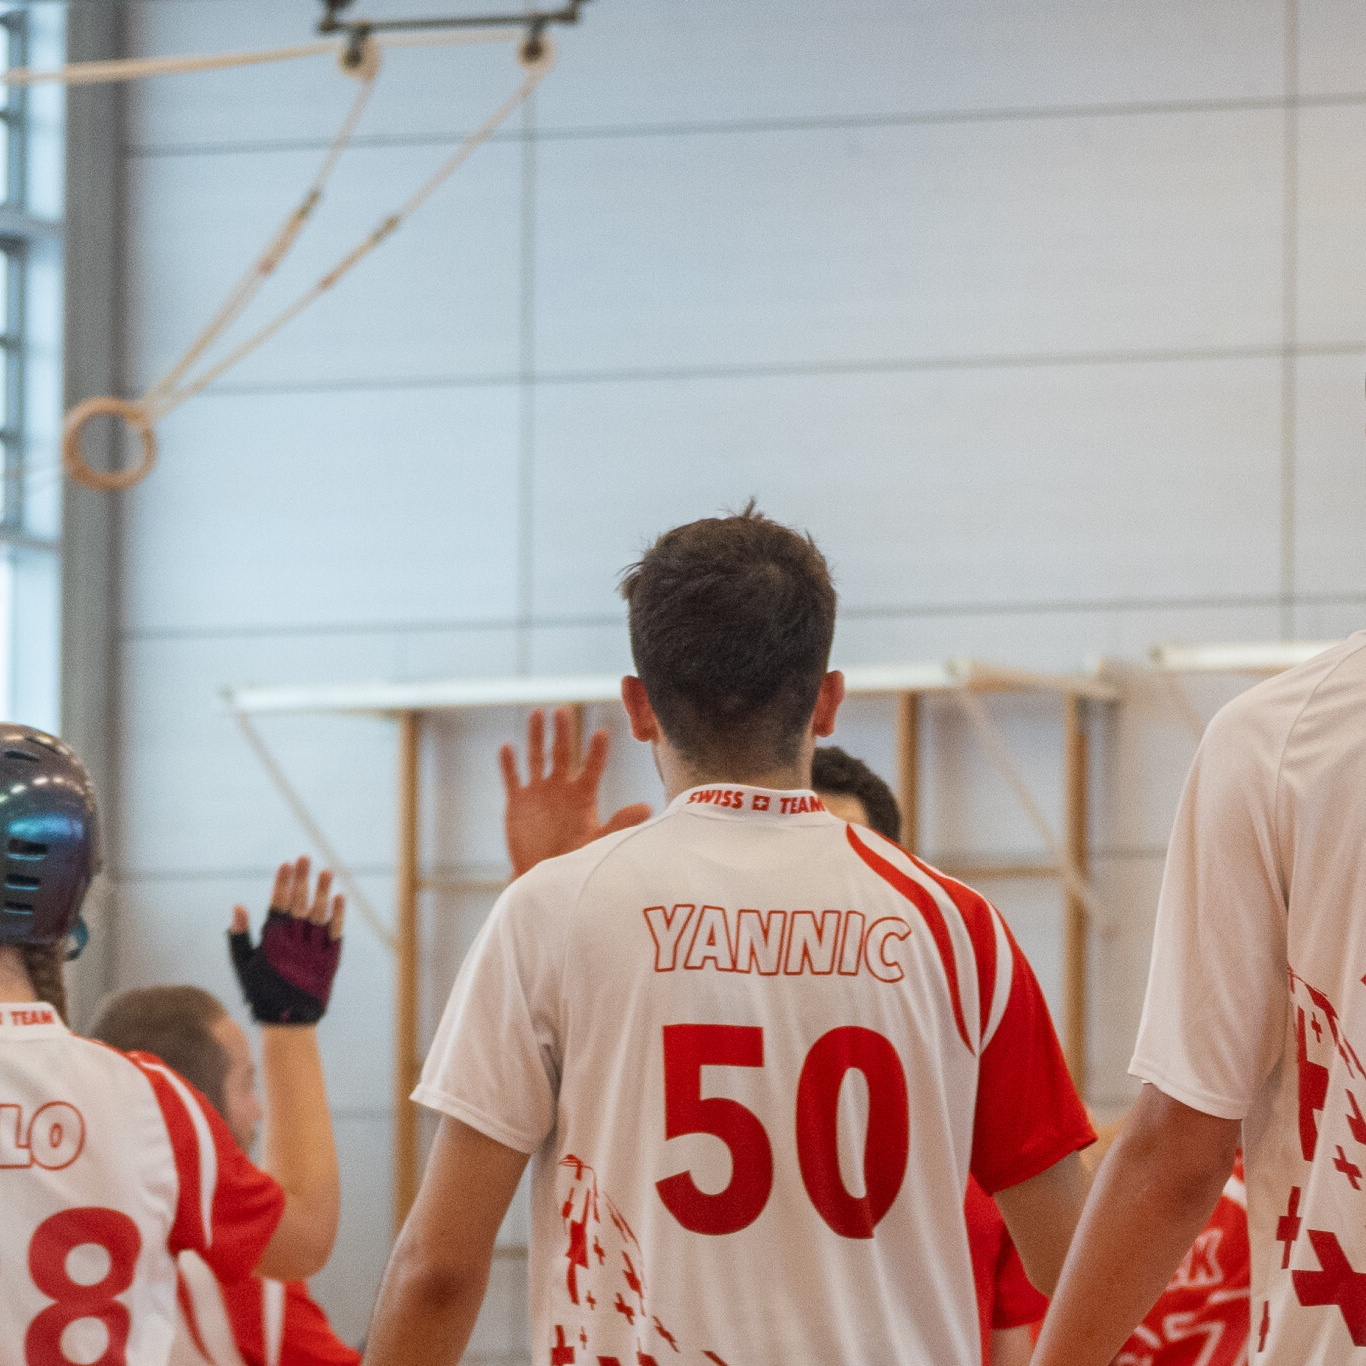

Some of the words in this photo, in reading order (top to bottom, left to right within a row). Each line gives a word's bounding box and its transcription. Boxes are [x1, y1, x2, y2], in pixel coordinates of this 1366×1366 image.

[687, 789, 745, 810] SWISS
[780, 795, 827, 814] TEAM
[643, 904, 911, 983] YANNIC
[10, 1010, 55, 1026] TEAM
[655, 1023, 910, 1240] 50
